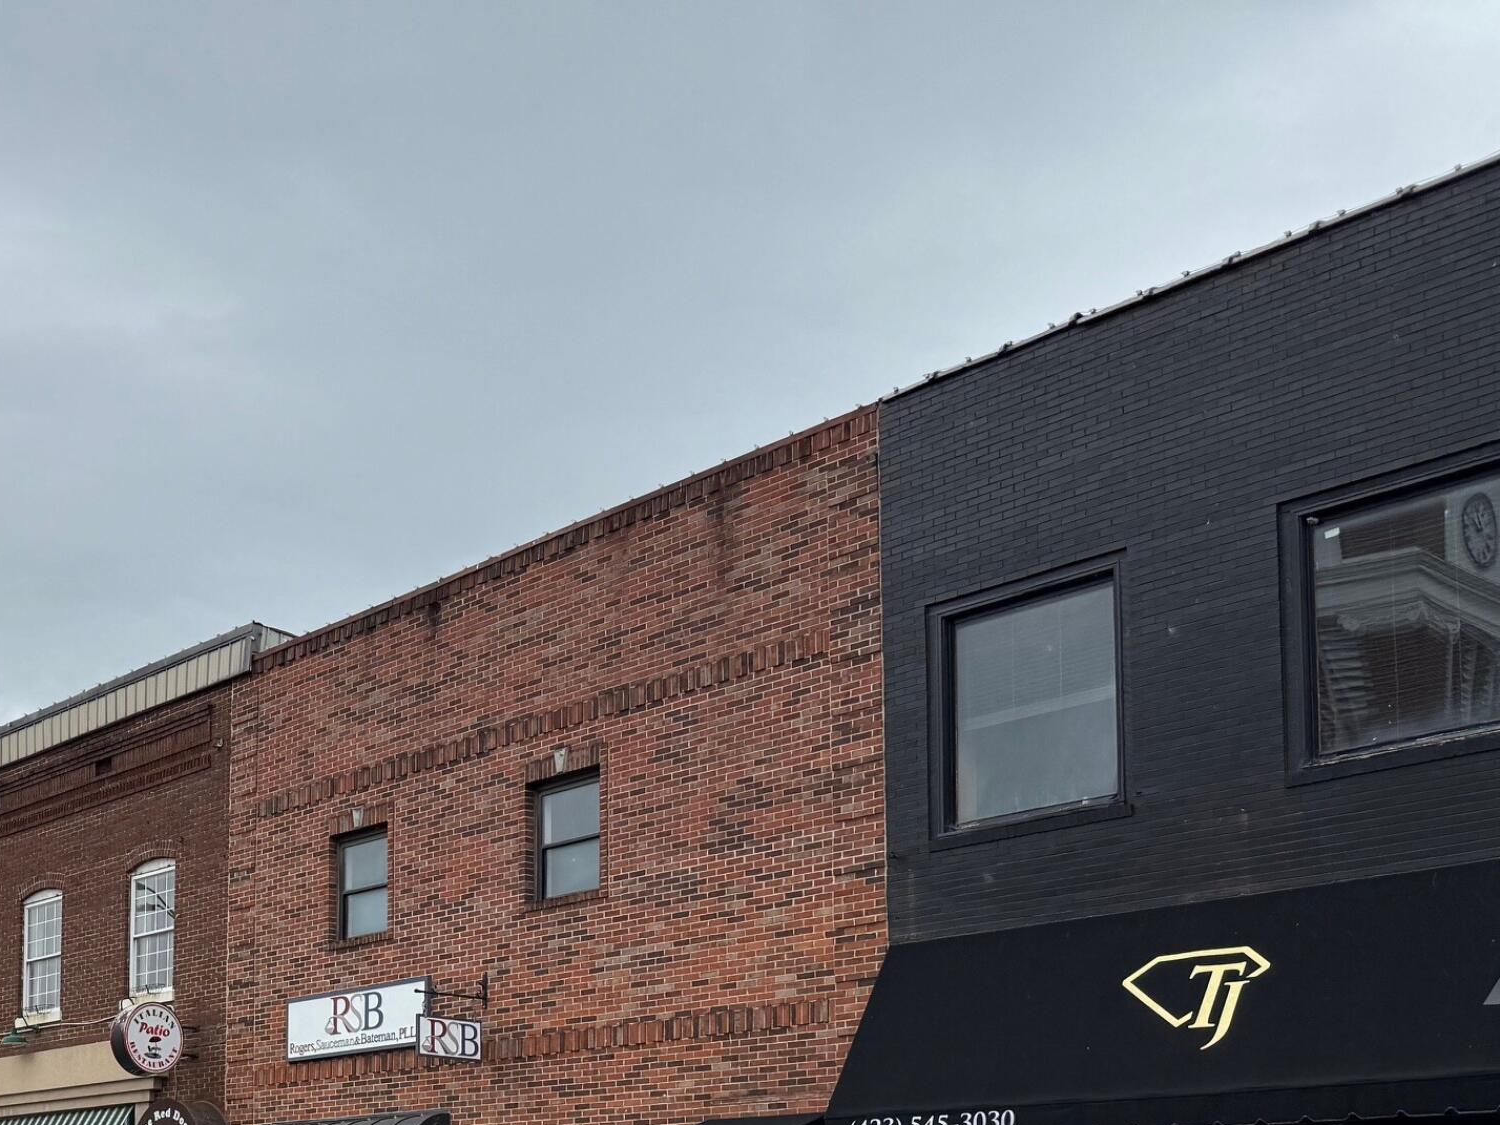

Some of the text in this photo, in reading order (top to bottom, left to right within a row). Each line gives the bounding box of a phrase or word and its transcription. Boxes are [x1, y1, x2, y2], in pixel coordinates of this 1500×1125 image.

[133, 1009, 175, 1029] ITALIAN
[330, 991, 384, 1035] RSB
[139, 1021, 170, 1037] Patio
[289, 1042, 316, 1056] Rogers,
[398, 1025, 417, 1040] PLL
[427, 1018, 479, 1057] RSB
[129, 1041, 178, 1068] RESTAURANT
[153, 1107, 171, 1122] Red
